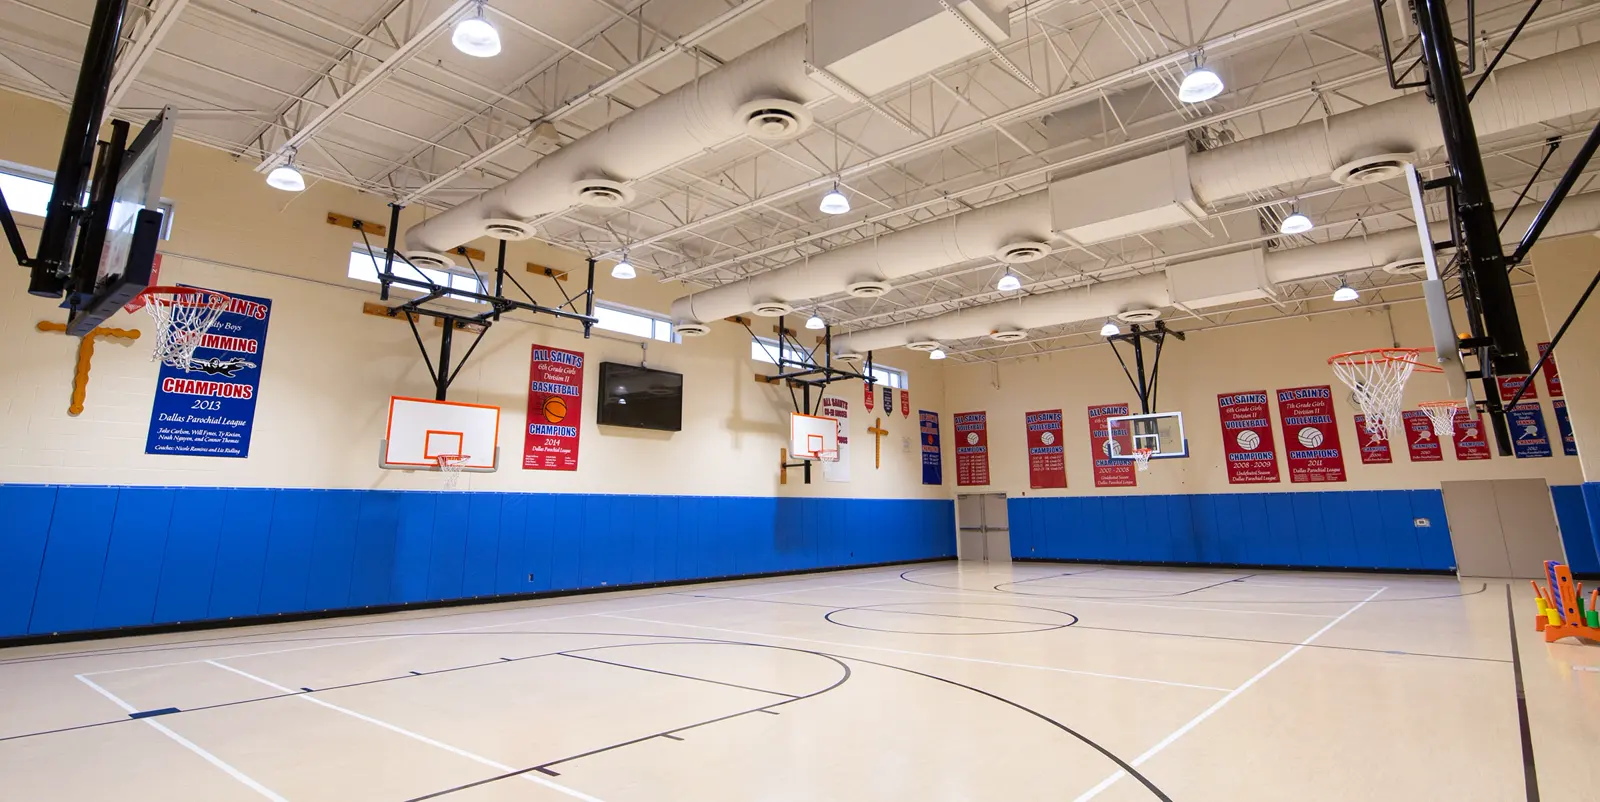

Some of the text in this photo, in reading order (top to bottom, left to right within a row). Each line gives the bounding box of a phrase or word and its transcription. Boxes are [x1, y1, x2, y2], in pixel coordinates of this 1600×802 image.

[224, 322, 242, 332] Boys
[533, 349, 582, 368] ALL SAINTS
[547, 365, 563, 373] Grade
[563, 367, 576, 375] Girls
[543, 373, 564, 381] Division
[162, 377, 254, 400] CHAMPIONS
[532, 380, 579, 396] BASKETBALL
[1279, 387, 1330, 402] ALL SAINTS
[190, 399, 221, 411] 2013
[1220, 394, 1267, 407] ALL SAINTS
[1089, 406, 1128, 417] ALL SAINTS
[158, 413, 247, 428] Dallas Parochial League
[964, 414, 986, 423] SAINTS
[1026, 412, 1062, 424] ALL SAINTS
[1224, 418, 1268, 429] VOLLEYBALL
[1285, 414, 1332, 425] VOLLEYBALL
[528, 423, 577, 438] CHAMPIONS
[1028, 422, 1061, 432] VOLLEYBALL
[173, 435, 193, 443] Nguyen,
[218, 430, 226, 438] Ty
[544, 438, 561, 446] 2014
[1030, 445, 1064, 455] CHAMPIONS
[1290, 449, 1339, 459] CHAMPIONS
[1229, 451, 1274, 461] CHAMPIONS
